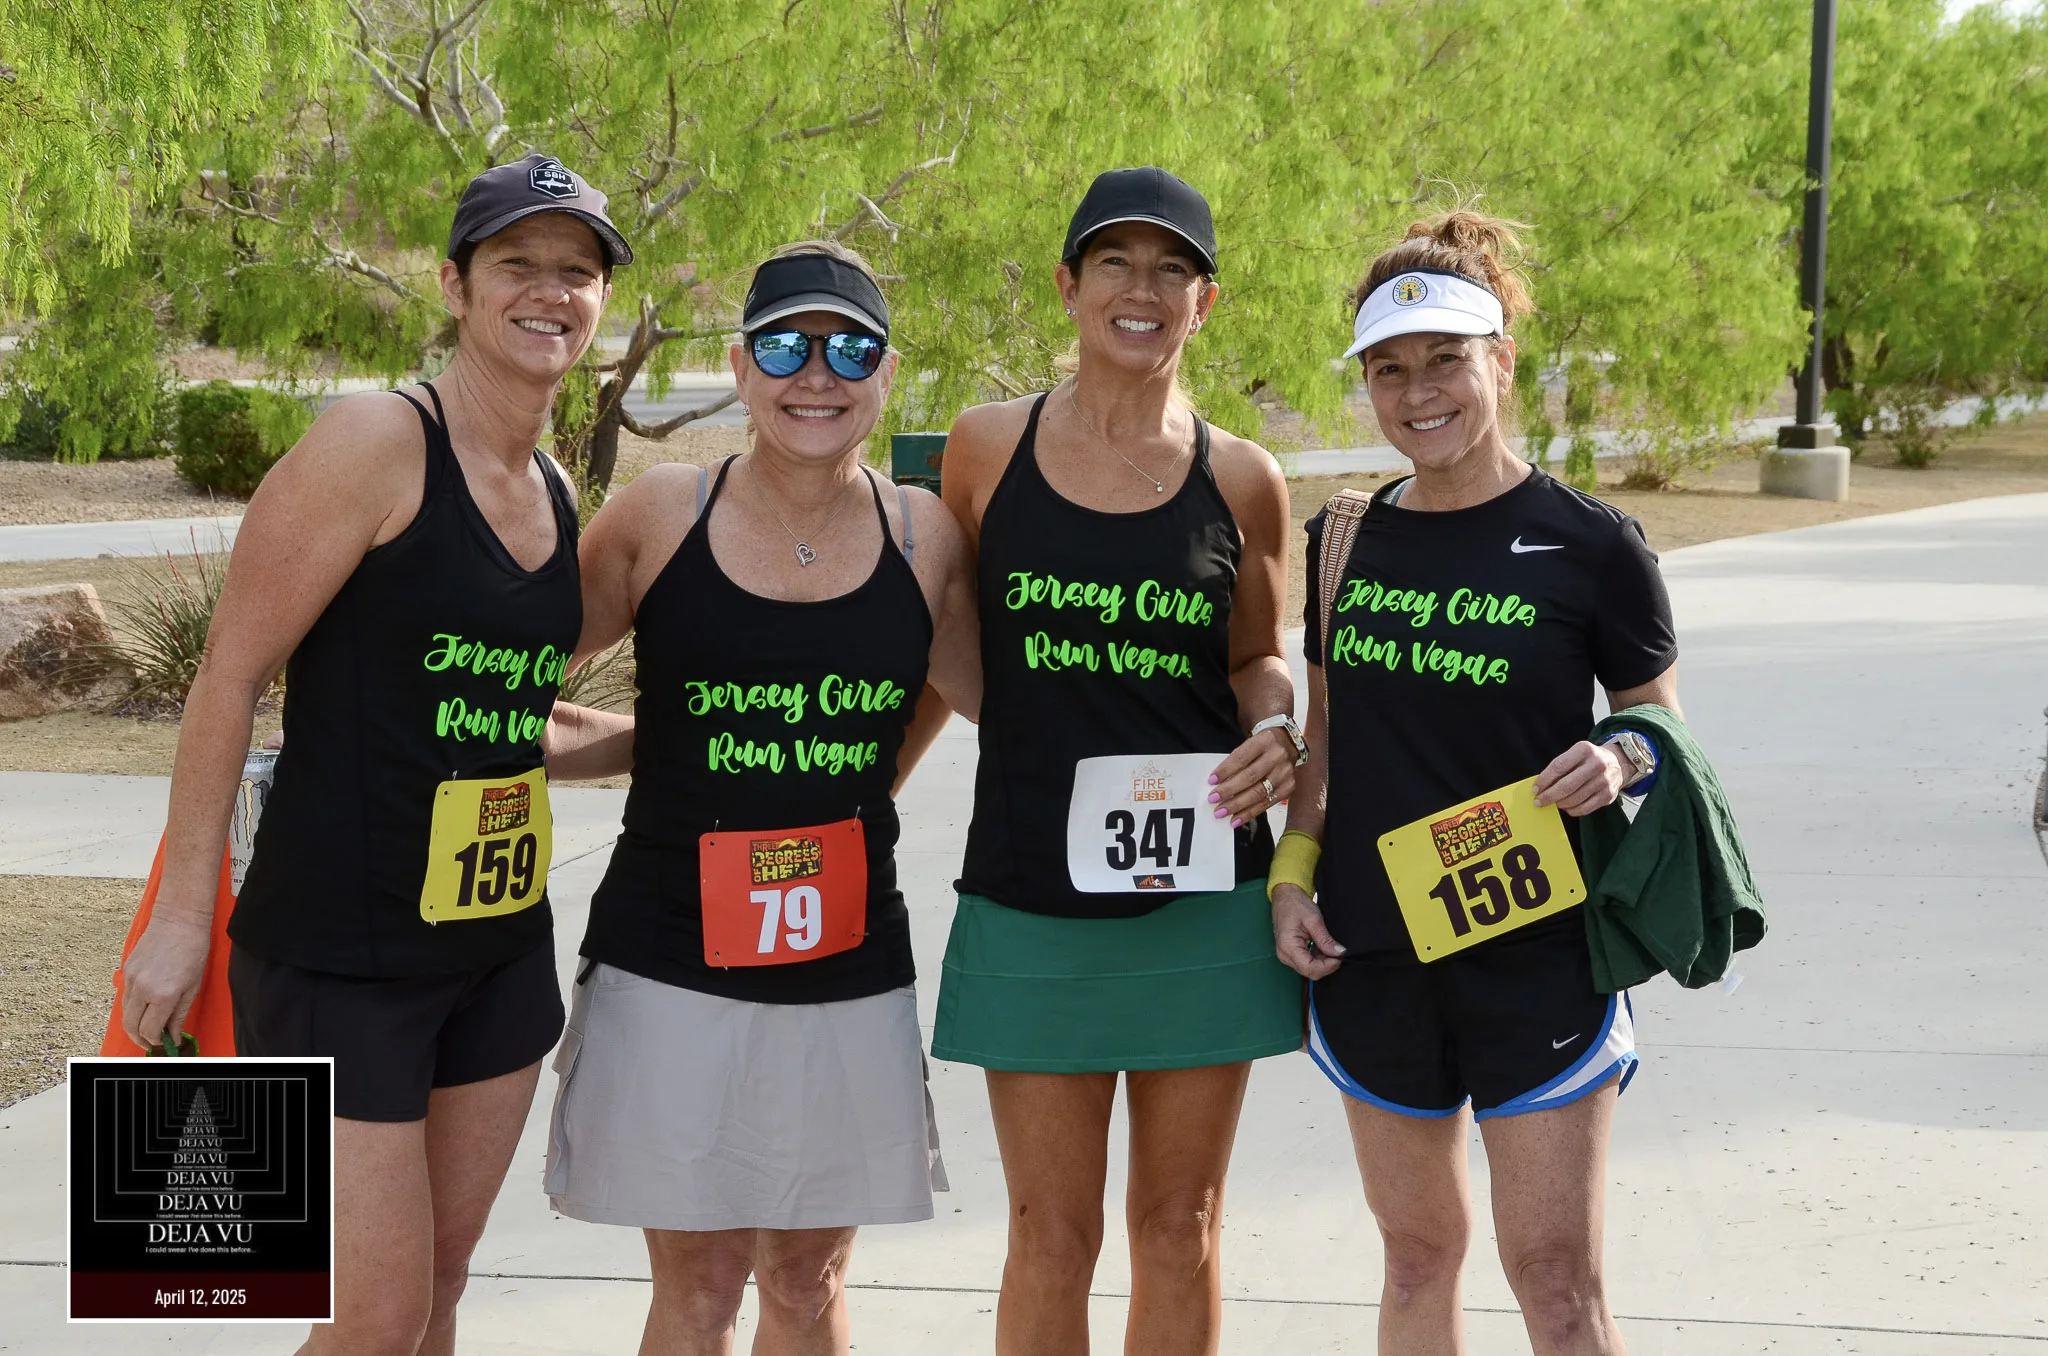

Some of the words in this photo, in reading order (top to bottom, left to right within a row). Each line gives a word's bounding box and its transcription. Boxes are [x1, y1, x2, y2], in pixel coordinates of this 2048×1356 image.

[544, 171, 566, 180] SBH
[1005, 571, 1127, 624] Jersey
[1135, 579, 1214, 627] Girls
[1336, 578, 1439, 628] Jersey
[1446, 587, 1537, 627] Girls
[423, 633, 531, 691] Jersey
[533, 644, 573, 688] Gir
[1024, 631, 1100, 672] Run
[1332, 624, 1402, 671] Run
[1412, 639, 1510, 686] Vegas
[684, 679, 809, 724] Jersey
[818, 674, 906, 716] Girls
[436, 697, 501, 744] Run
[708, 732, 787, 774] Run
[794, 735, 879, 776] Vegas
[1133, 778, 1166, 790] FIRE
[1135, 790, 1165, 801] FEST
[480, 818, 487, 833] OF
[487, 810, 528, 831] HELL
[482, 794, 529, 817] DEGREES
[752, 841, 778, 852] THREE
[1105, 808, 1196, 871] 347
[1433, 819, 1459, 835] THREE
[1435, 811, 1504, 850] DEGREES
[1441, 850, 1453, 865] OF
[1449, 827, 1508, 861] HELL
[454, 832, 538, 907] 159
[752, 846, 819, 868] DEGREES
[753, 868, 761, 883] OF
[762, 861, 819, 882] HELL
[1428, 843, 1552, 938] 158
[750, 885, 823, 954] 79
